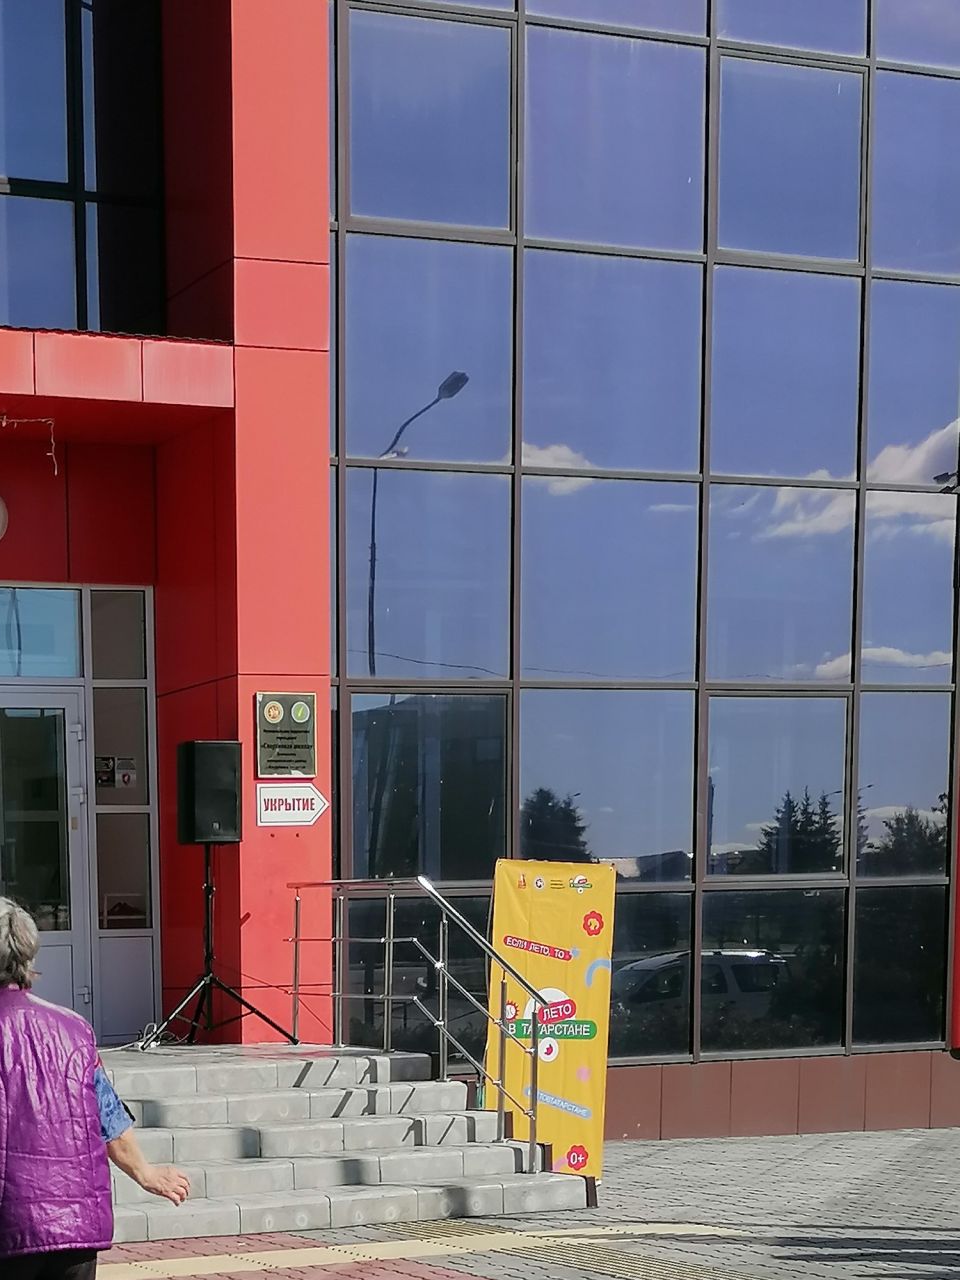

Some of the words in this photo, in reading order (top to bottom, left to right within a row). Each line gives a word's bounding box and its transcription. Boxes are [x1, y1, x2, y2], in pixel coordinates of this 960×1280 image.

[263, 797, 316, 812] УКРЫТИЕ
[506, 937, 527, 949] ЕСЛИ
[554, 949, 565, 958] ТО
[543, 1003, 572, 1021] ЛЕТО
[508, 1023, 516, 1034] В
[522, 1024, 590, 1035] ТААРСТАНЕ
[570, 1152, 585, 1165] 0+
